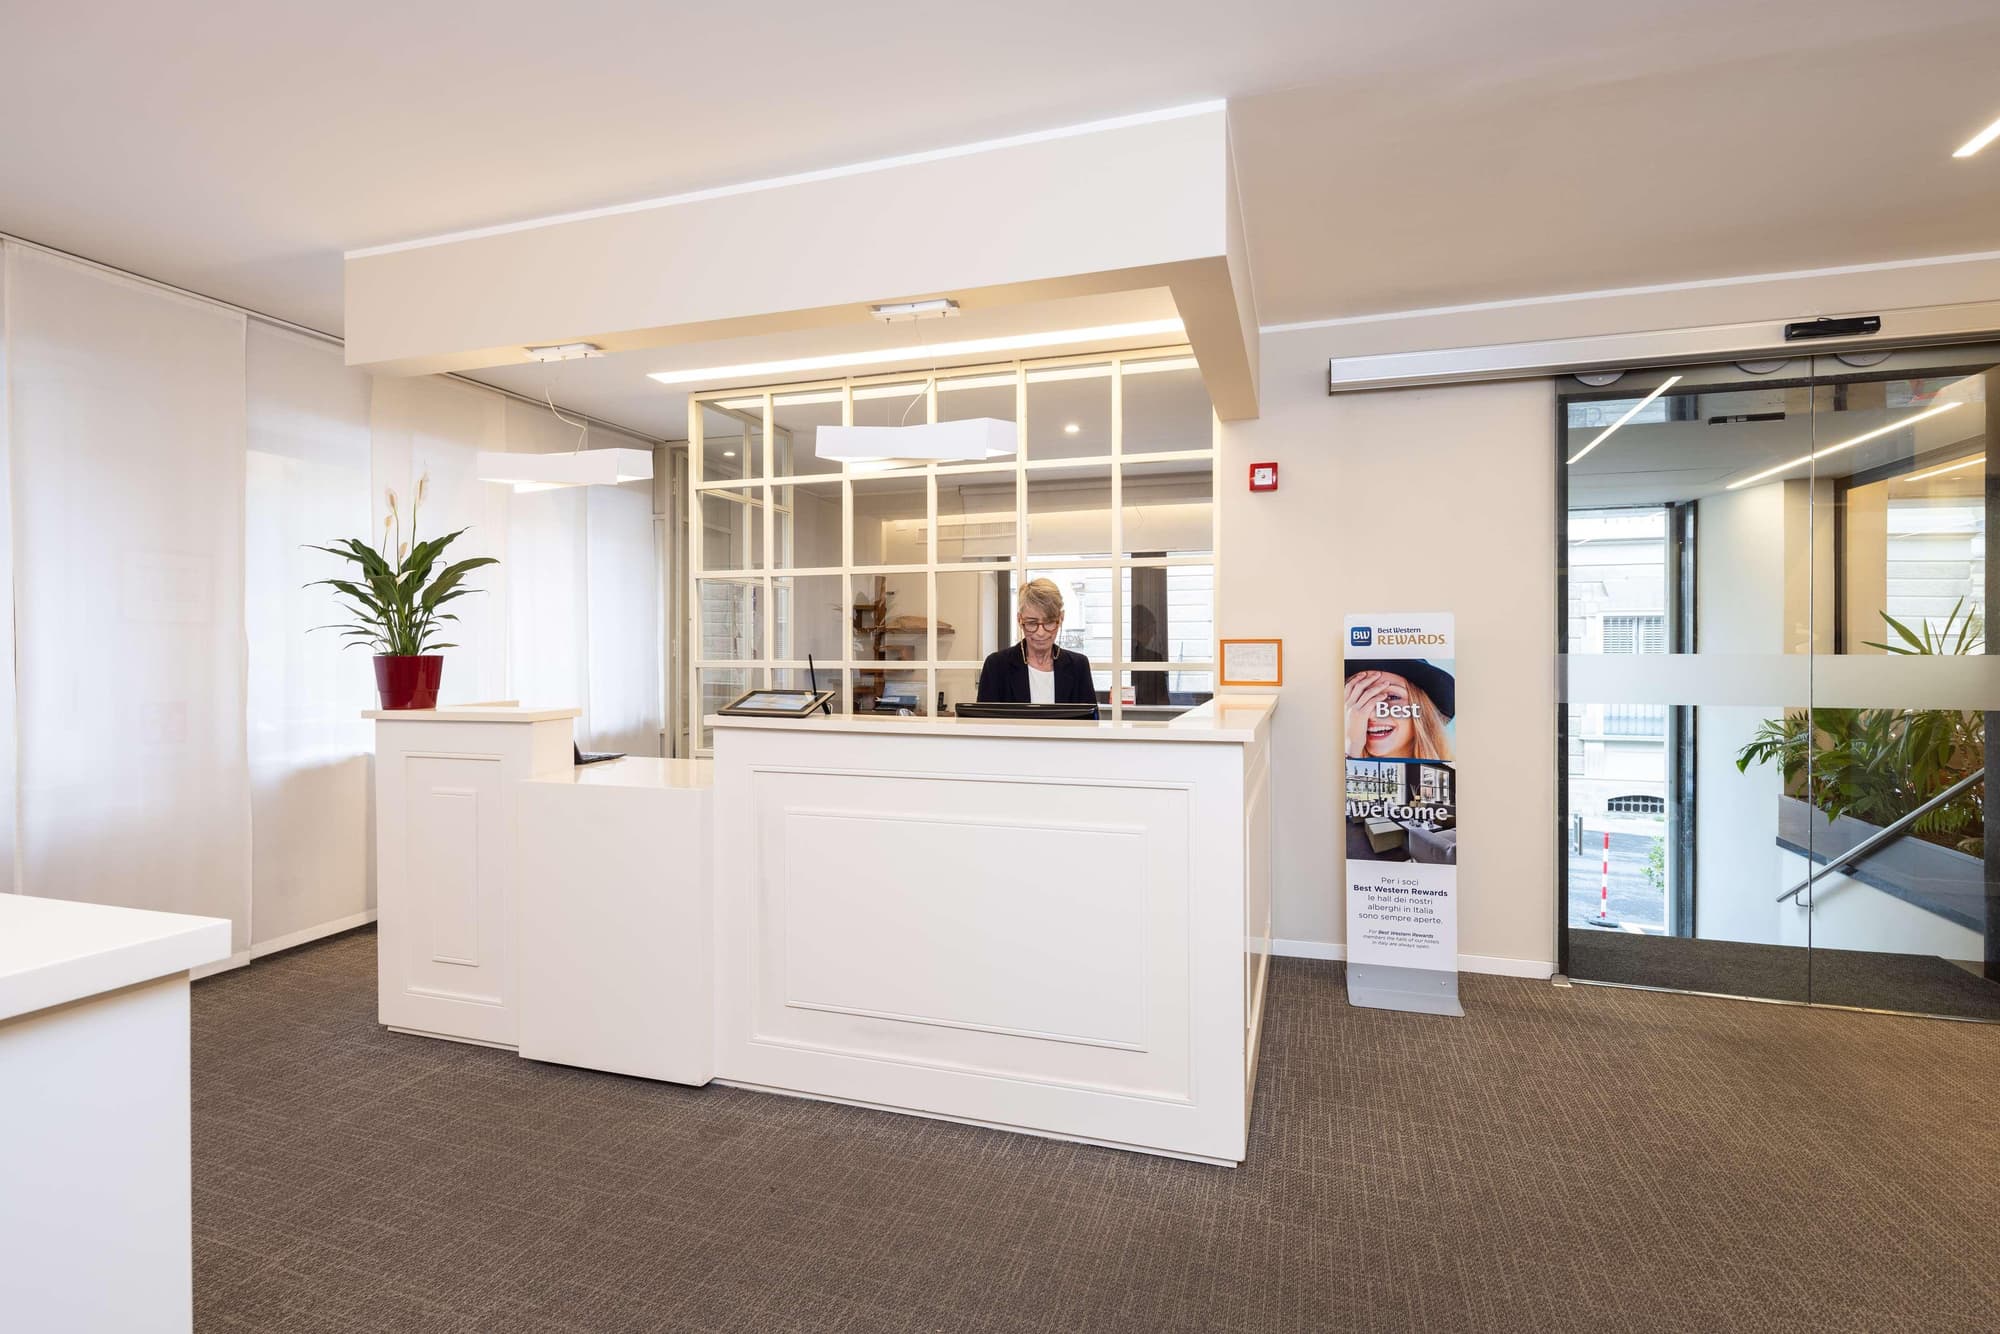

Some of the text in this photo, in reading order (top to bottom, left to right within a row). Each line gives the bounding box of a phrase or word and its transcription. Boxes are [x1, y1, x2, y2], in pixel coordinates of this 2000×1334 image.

[1378, 634, 1446, 645] REWARDS
[1375, 701, 1421, 718] Best
[1351, 801, 1448, 821] Welcome
[1353, 884, 1448, 897] Best Western Rewards
[1409, 897, 1433, 905] nostri
[1367, 904, 1401, 913] alberghi
[1413, 906, 1434, 914] Italia
[1380, 914, 1412, 922] sempre
